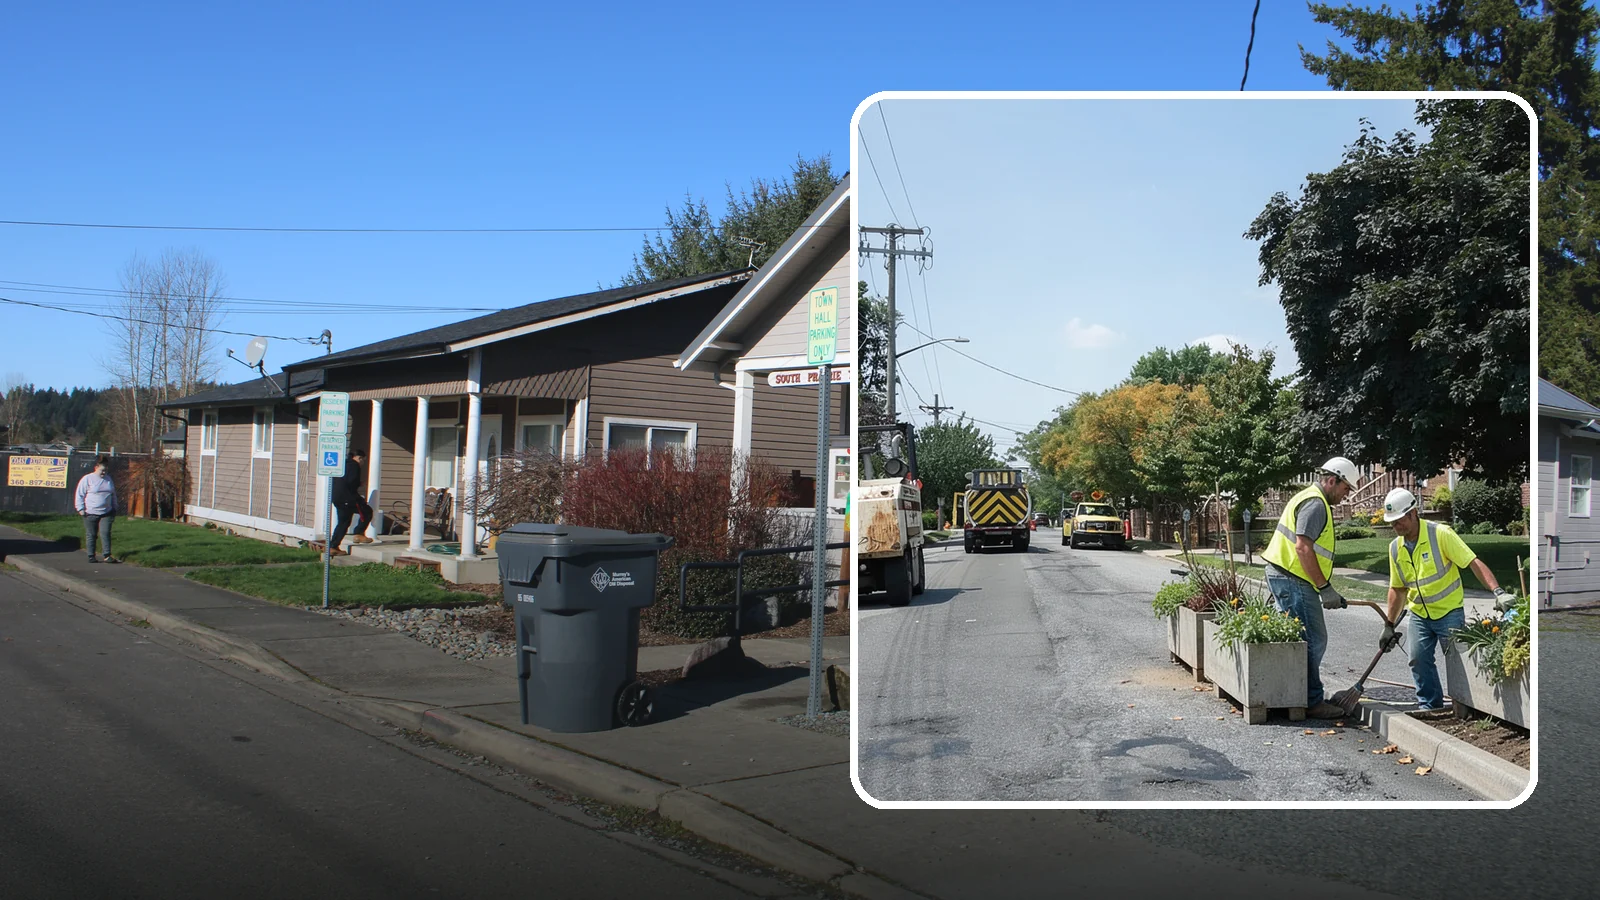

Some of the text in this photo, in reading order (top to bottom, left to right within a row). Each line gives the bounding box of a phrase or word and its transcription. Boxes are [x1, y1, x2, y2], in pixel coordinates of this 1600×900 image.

[815, 295, 833, 308] TOWN
[814, 311, 831, 325] HALL
[810, 326, 836, 341] PARKING
[813, 344, 831, 357] ONLY
[775, 373, 801, 385] SOUTH
